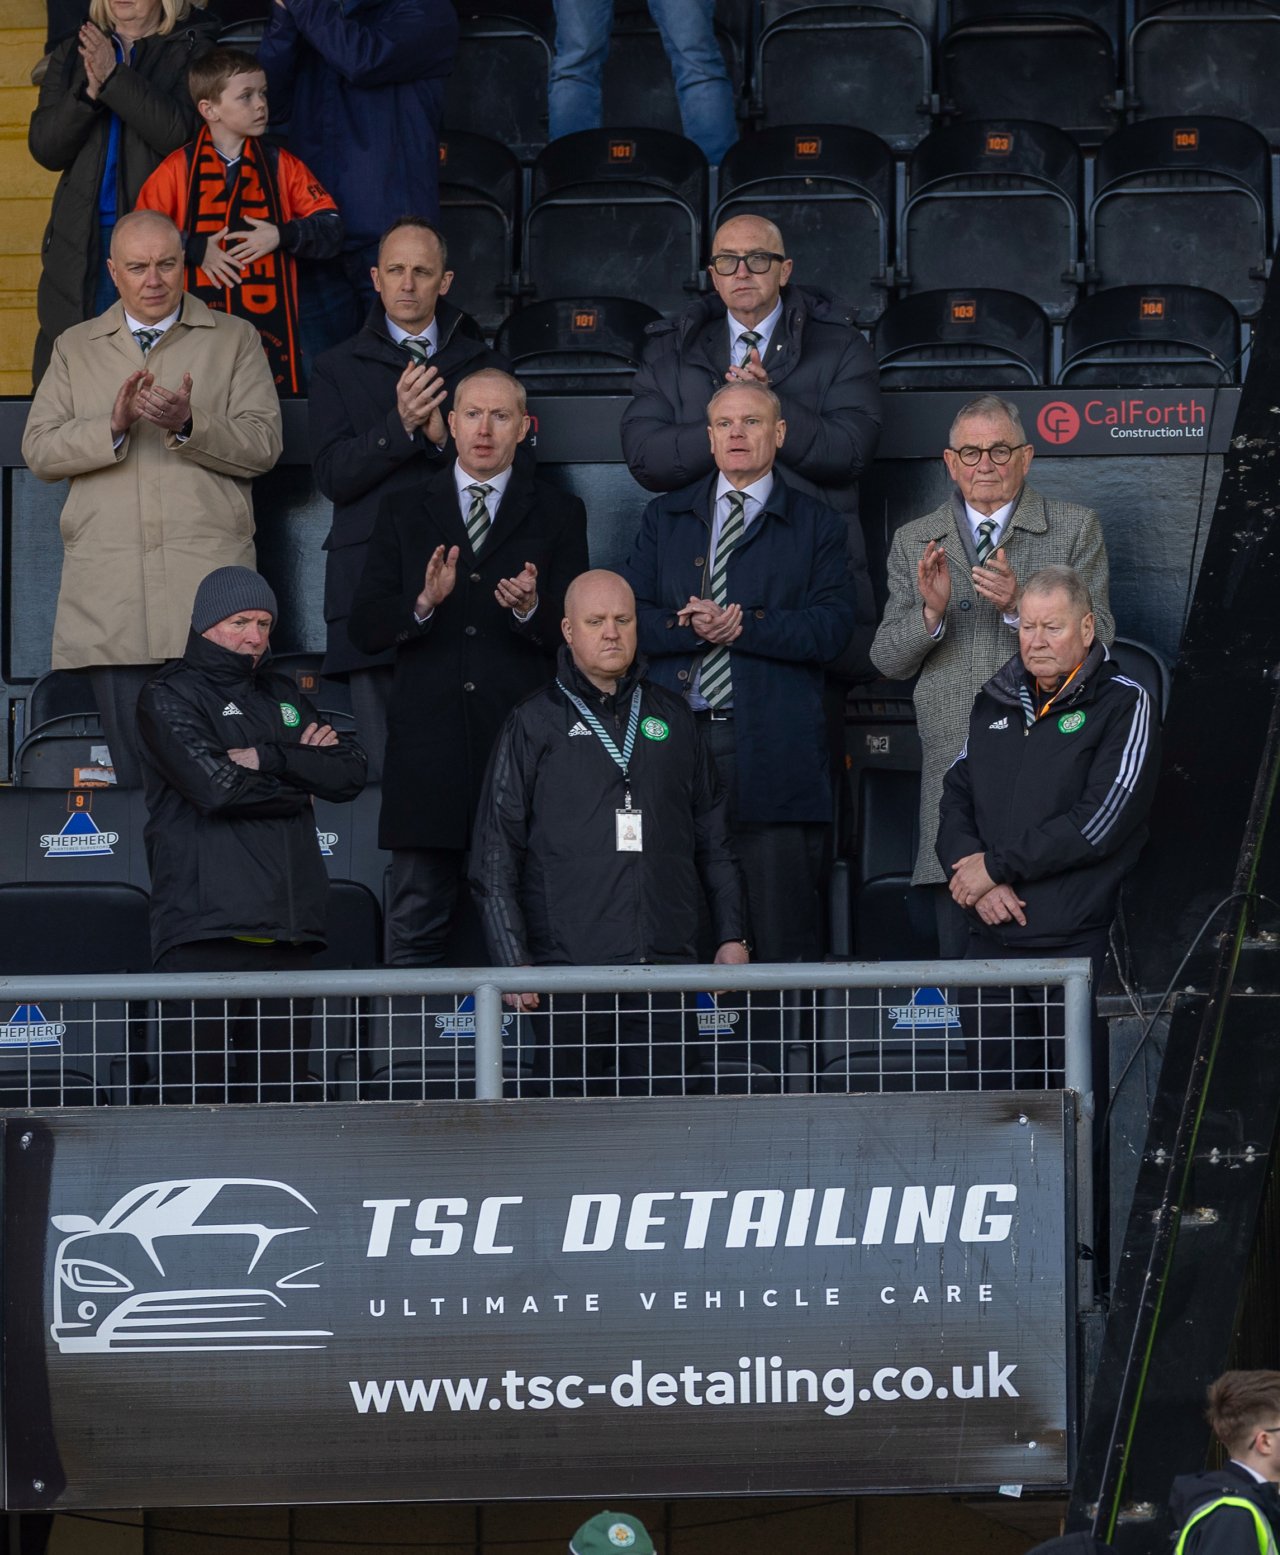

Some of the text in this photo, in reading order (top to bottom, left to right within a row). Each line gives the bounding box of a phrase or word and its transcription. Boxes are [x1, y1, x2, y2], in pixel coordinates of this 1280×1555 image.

[988, 138, 1010, 150] 103
[1178, 134, 1197, 146] 104
[611, 145, 630, 158] 101
[796, 142, 818, 154] 102
[953, 305, 974, 318] 103
[1143, 302, 1162, 314] 104
[575, 314, 593, 327] 101
[1084, 400, 1206, 425] CalForth
[1110, 427, 1204, 438] Construction Ltd
[301, 676, 314, 688] 10
[75, 795, 84, 807] 9
[41, 833, 118, 846] SHEPHERD
[363, 1183, 1018, 1257] TSC DETAILING
[370, 1284, 993, 1318] ULTIMATE VEHICLE CARE
[349, 1351, 1020, 1416] www.tsc-detailing.co.uk
